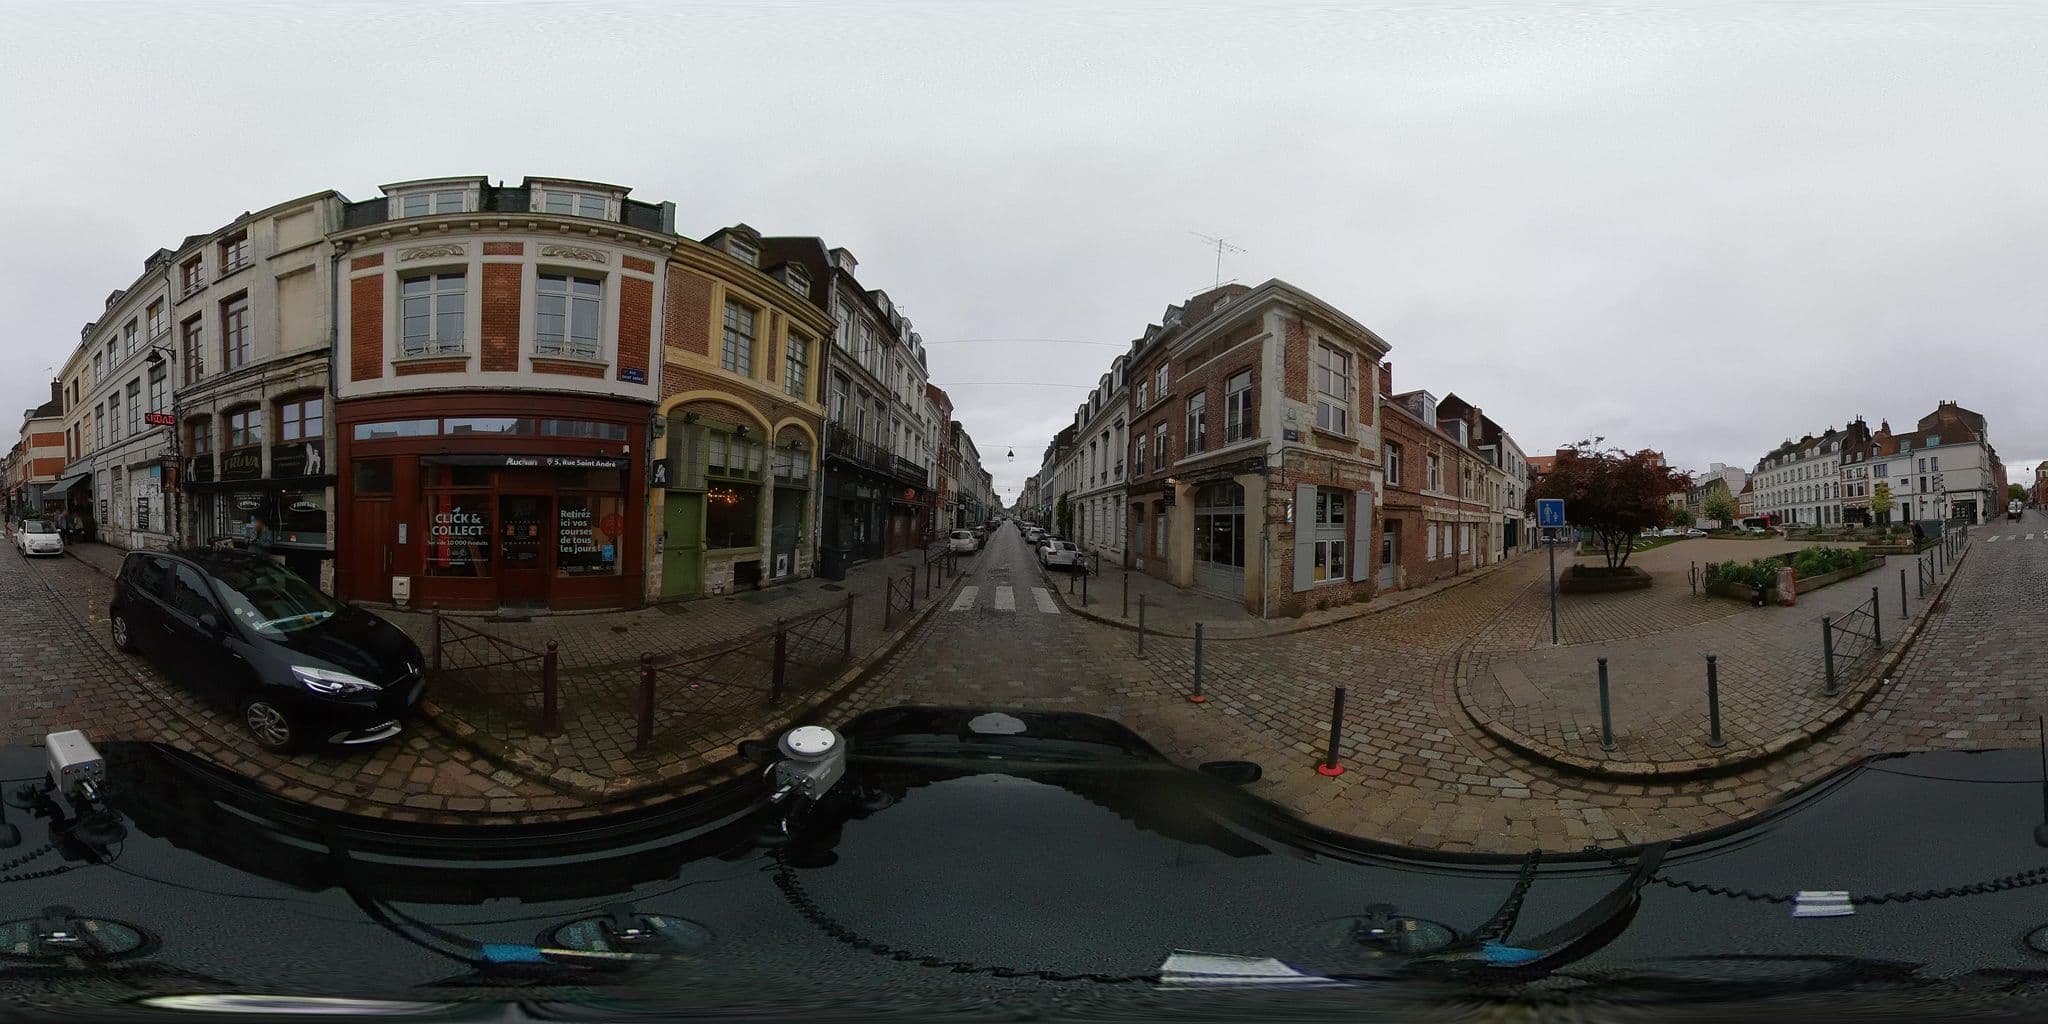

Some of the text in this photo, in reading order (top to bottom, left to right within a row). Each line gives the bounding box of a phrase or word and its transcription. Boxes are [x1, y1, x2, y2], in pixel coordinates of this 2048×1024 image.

[577, 459, 595, 467] Saint
[435, 513, 481, 524] CLICK &
[560, 519, 570, 527] ici
[431, 525, 484, 536] COLLECT
[560, 536, 571, 544] de
[560, 545, 572, 553] les
[573, 545, 596, 554] jours
